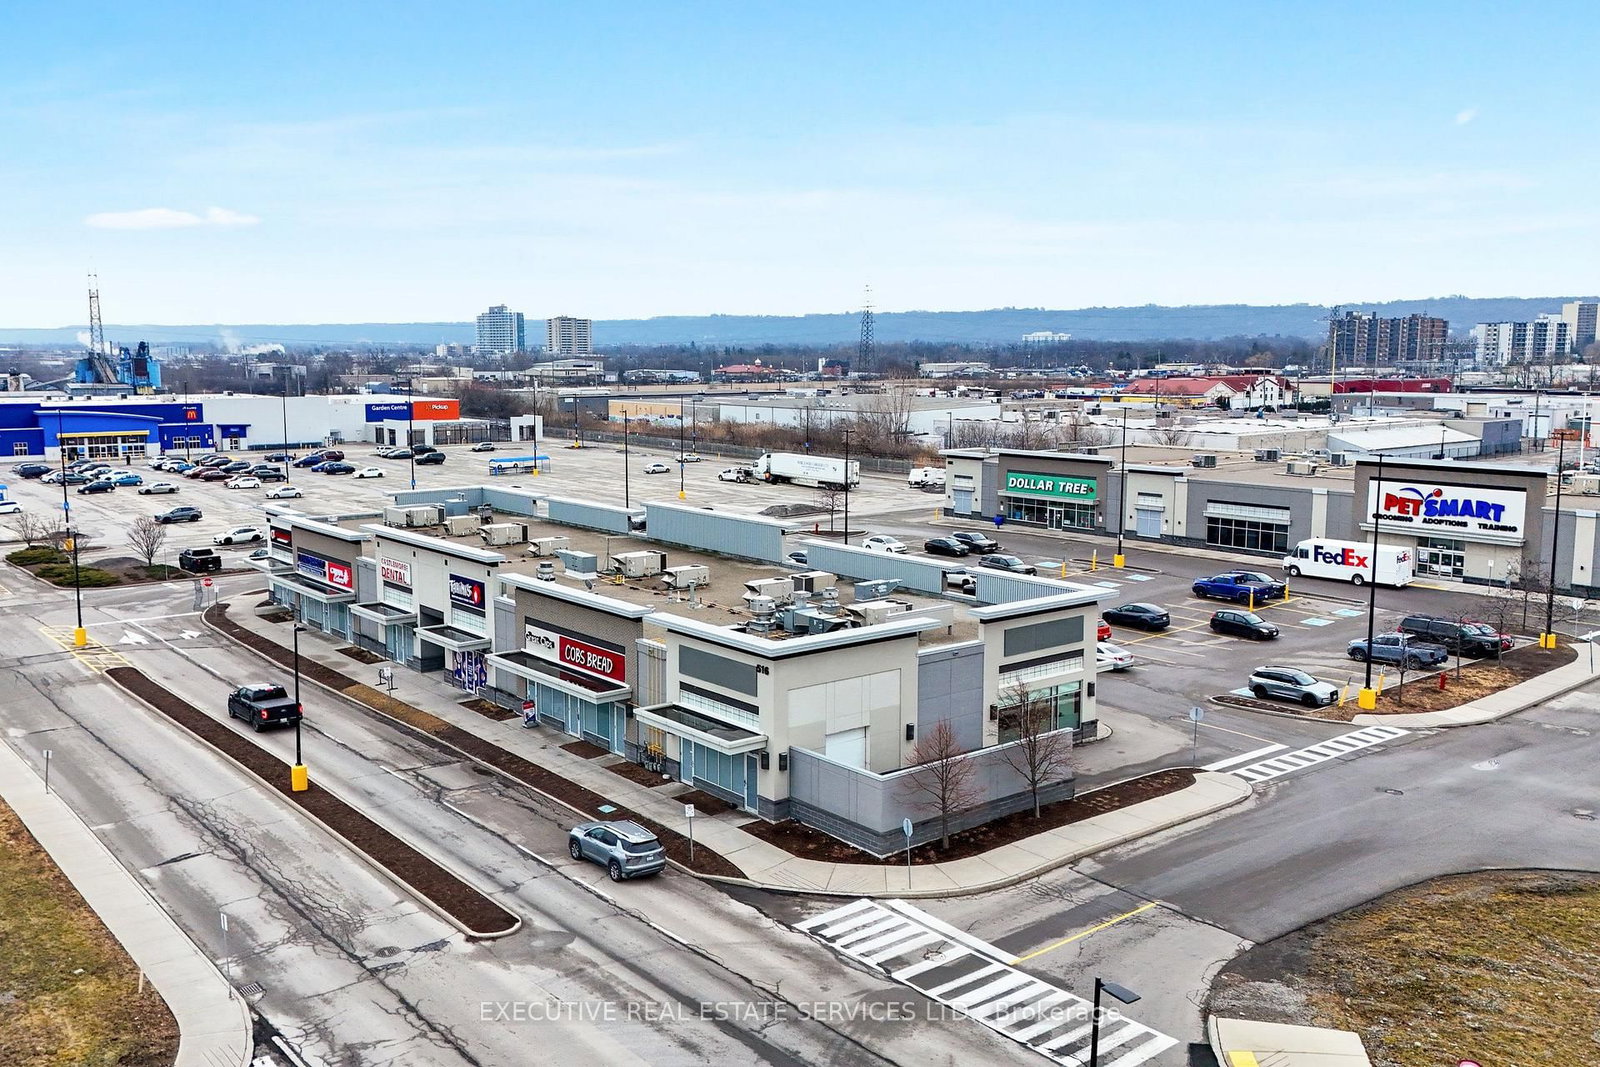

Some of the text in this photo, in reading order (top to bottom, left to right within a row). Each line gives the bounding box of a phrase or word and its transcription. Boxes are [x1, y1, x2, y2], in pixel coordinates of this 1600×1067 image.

[1008, 477, 1088, 494] DOLLAR TREE
[1384, 492, 1505, 523] PETSMART
[1422, 517, 1468, 528] ADOPTIONS
[1478, 522, 1518, 533] TRAINING
[1313, 544, 1369, 569] FedEx
[1396, 551, 1411, 564] FedEx
[381, 566, 409, 585] DENTAL
[564, 644, 613, 674] COBS BREAD
[756, 663, 770, 676] 516
